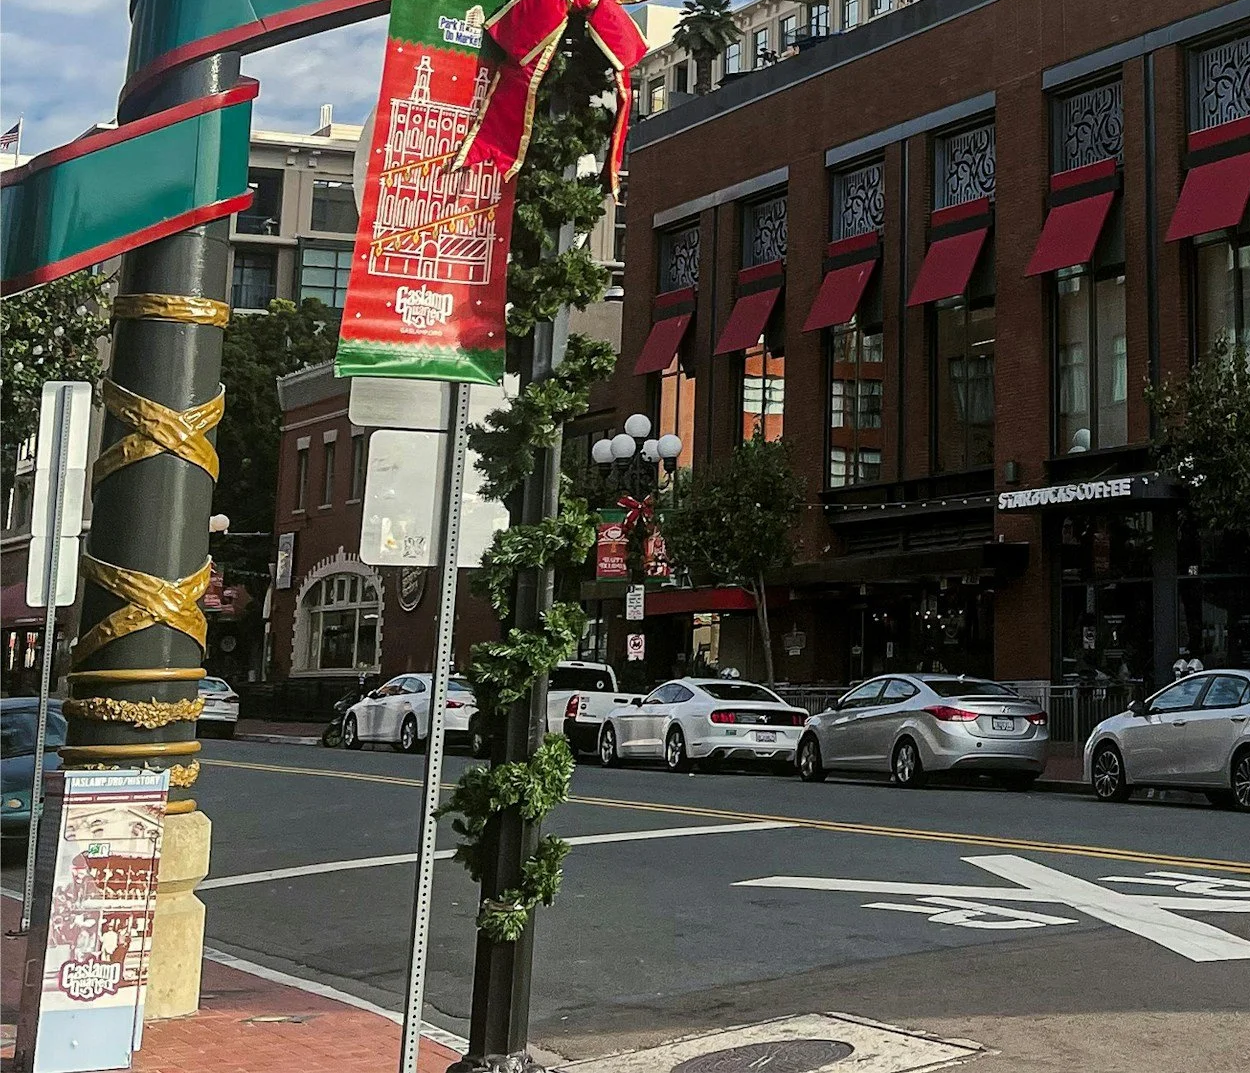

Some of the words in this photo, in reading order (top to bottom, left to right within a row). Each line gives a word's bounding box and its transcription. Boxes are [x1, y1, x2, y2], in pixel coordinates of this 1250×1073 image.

[395, 283, 454, 316] Gaslamp
[402, 305, 446, 328] Quarter
[998, 484, 1078, 510] STARBUCKS
[1077, 478, 1131, 501] COFFEE
[63, 959, 121, 989] Gaslamp
[70, 977, 116, 998] Quarter
